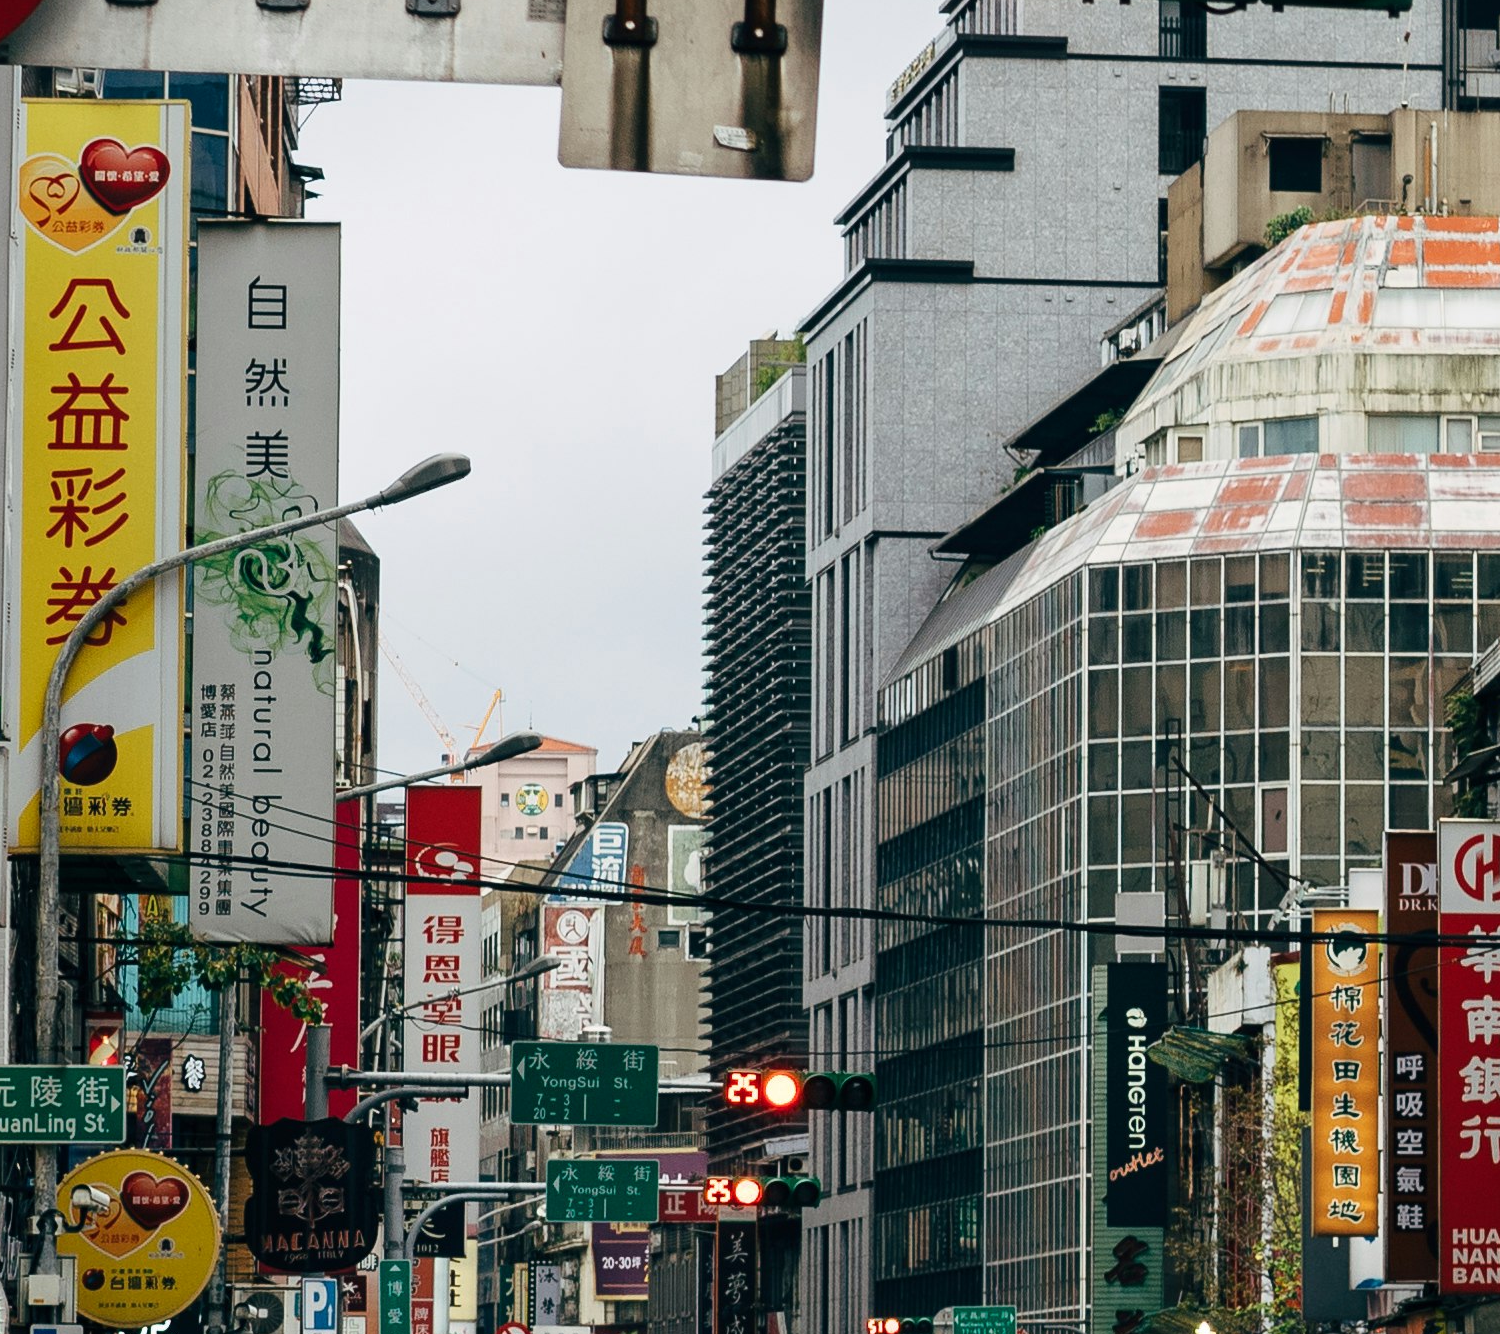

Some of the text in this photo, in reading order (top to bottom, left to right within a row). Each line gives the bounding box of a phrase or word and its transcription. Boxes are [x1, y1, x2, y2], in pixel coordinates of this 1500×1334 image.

[245, 276, 291, 481] 自然美
[47, 277, 131, 648] 公益彩券
[200, 684, 217, 738] 博愛店
[241, 649, 283, 917] natural beauty
[529, 1047, 646, 1072] 永綏街
[541, 1076, 633, 1090] YongSui St.
[729, 1072, 759, 1104] 25
[1328, 983, 1364, 1224] 棉花田生機園地
[84, 1112, 110, 1134] St.
[1396, 1054, 1424, 1231] 呼吸空氣鞋
[562, 1164, 651, 1182] 永綏街
[1110, 1146, 1164, 1182] outlet
[572, 1185, 641, 1195] YongSui St.
[706, 1179, 731, 1203] 25
[1453, 1228, 1500, 1245] HUA
